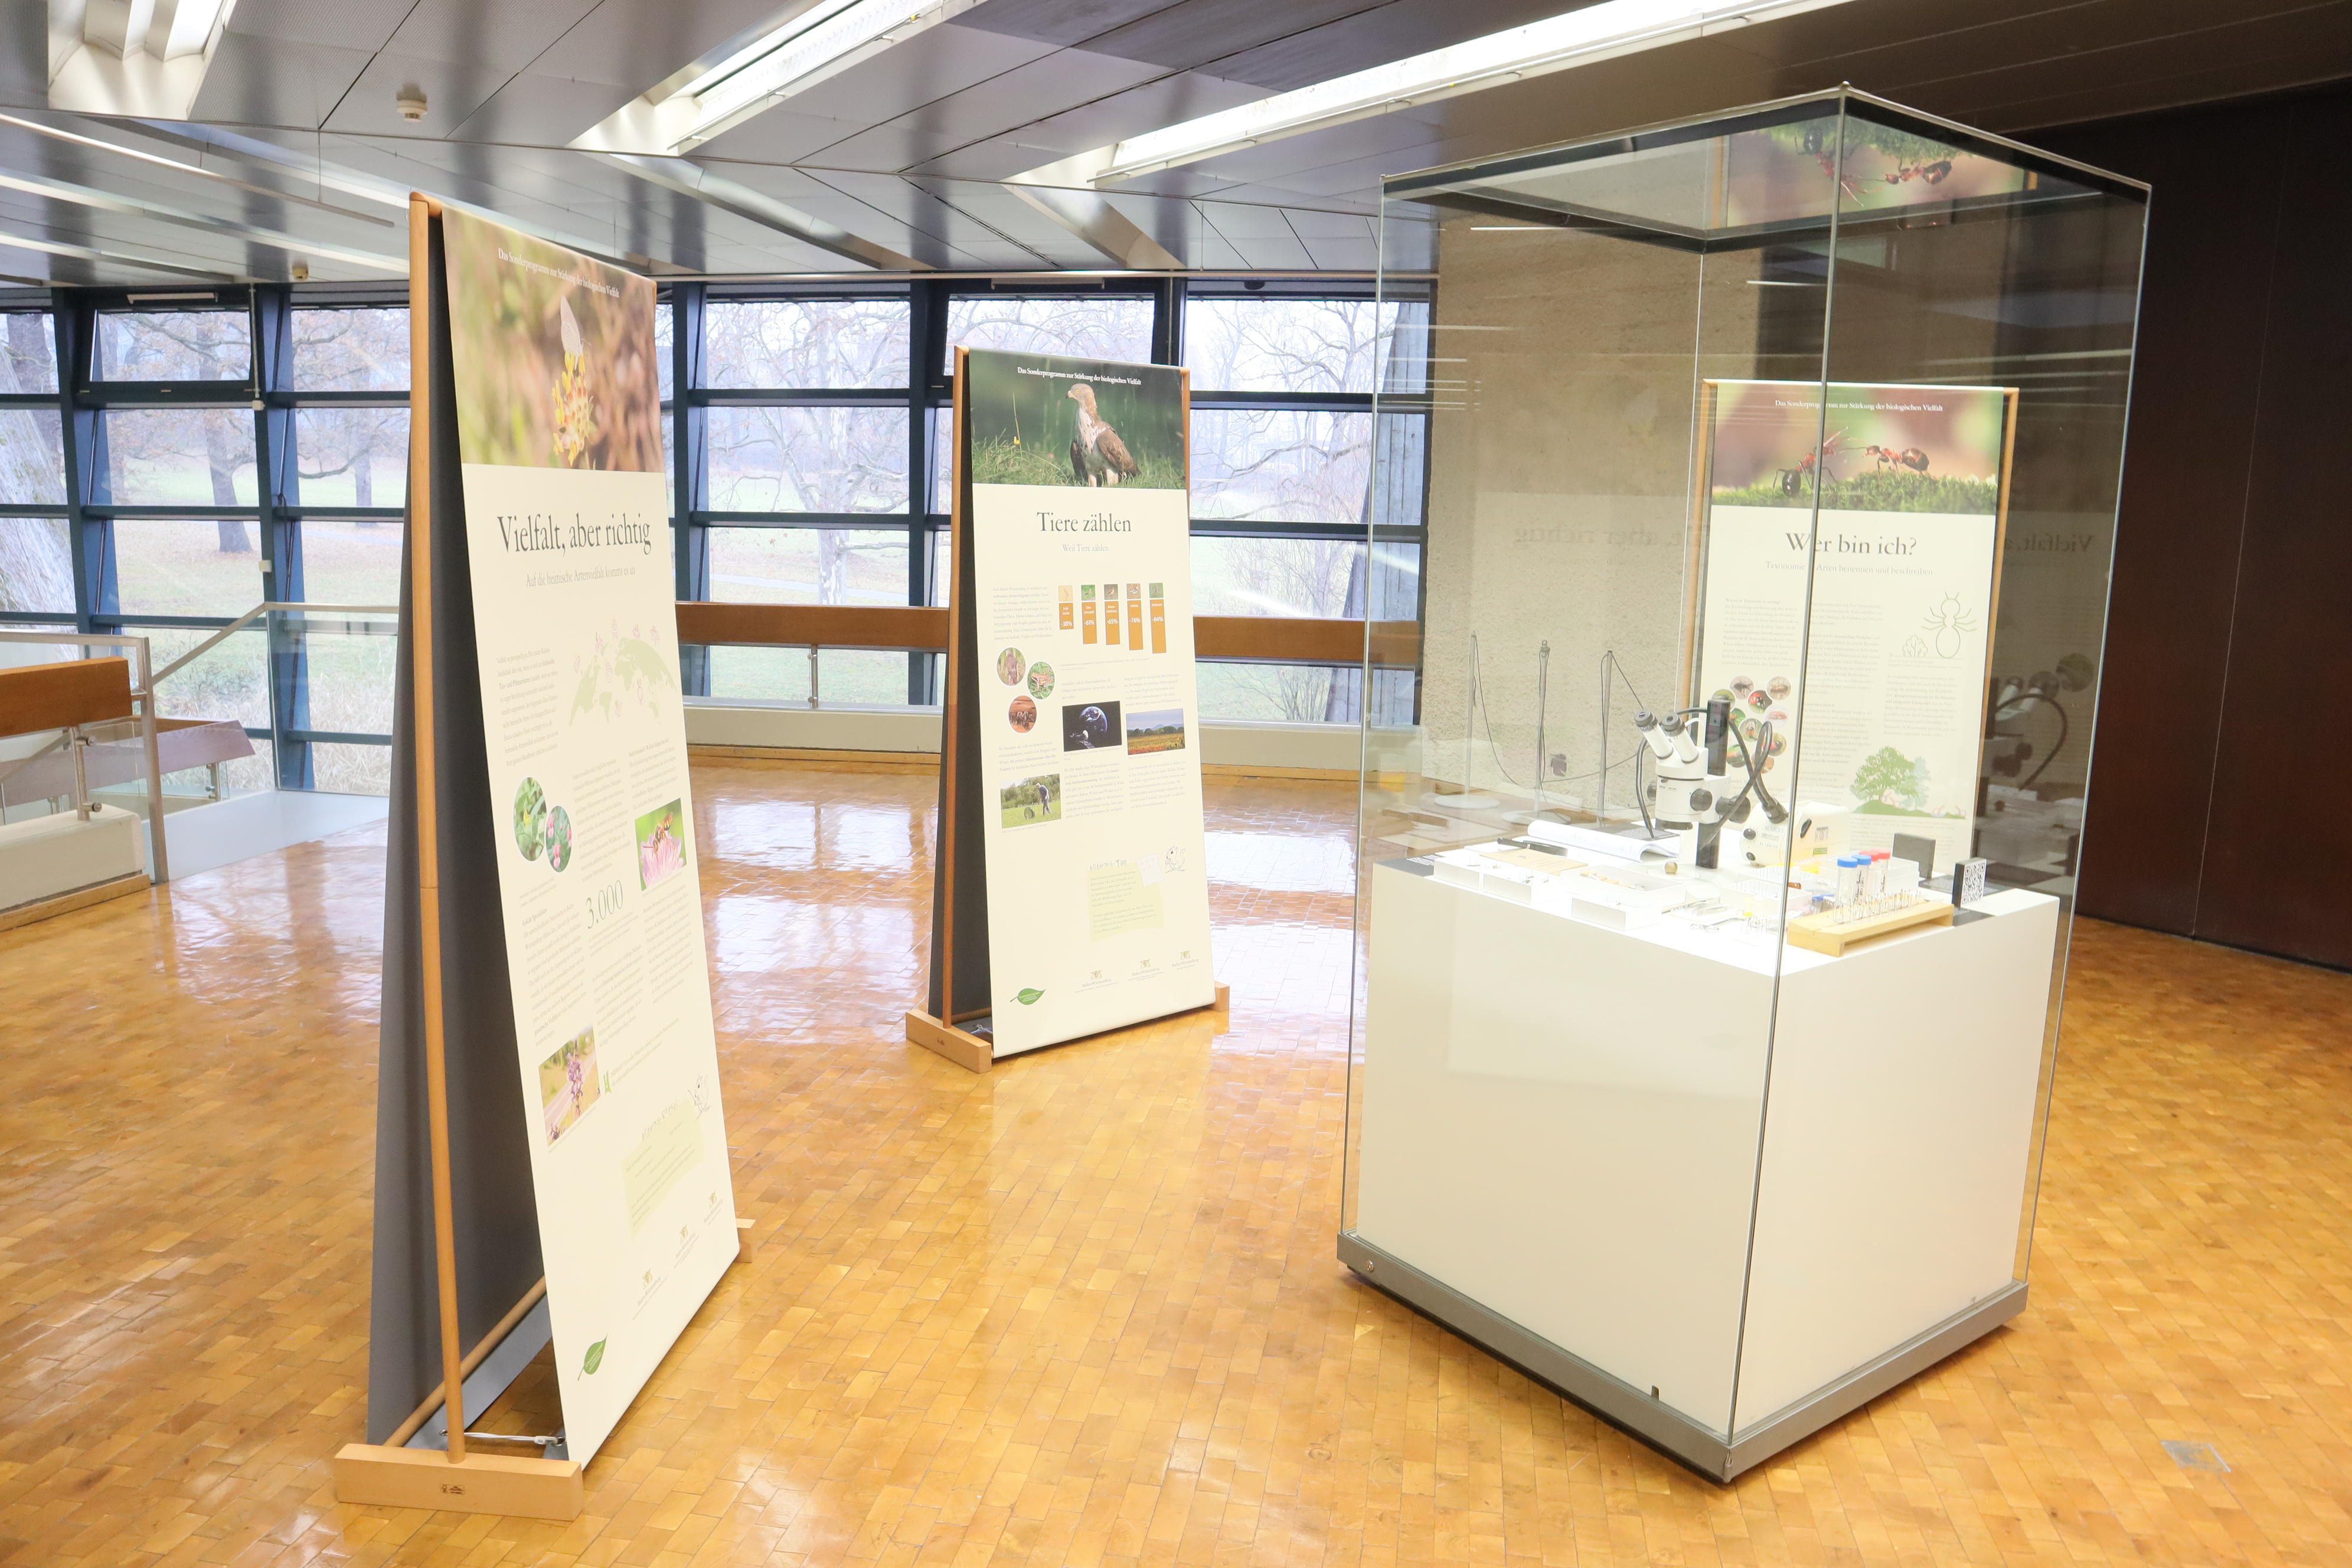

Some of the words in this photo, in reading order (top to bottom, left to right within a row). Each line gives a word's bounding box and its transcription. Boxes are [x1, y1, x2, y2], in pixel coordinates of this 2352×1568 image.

[498, 248, 508, 261] Das
[509, 252, 549, 274] Sonderprogramm
[558, 268, 576, 286] Stärkung
[583, 276, 606, 293] biologischen
[606, 285, 619, 298] Vielfalt
[1027, 368, 1066, 378] Sonderprogramm
[1074, 373, 1093, 381] Stärkung
[1101, 375, 1126, 384] biologischen
[1849, 402, 1875, 410] Stärkung
[1886, 403, 1921, 412] biologischen
[1037, 511, 1078, 532] Tiere
[1083, 512, 1132, 532] zählen
[496, 514, 566, 557] Vielfalt,
[569, 512, 601, 548] aber
[606, 512, 651, 555] richtig
[1785, 533, 1831, 551] Wer
[1838, 534, 1870, 554] bin
[1878, 536, 1917, 555] ich?
[527, 573, 536, 587] Auf
[537, 572, 545, 586] die
[547, 570, 573, 584] heimische
[574, 566, 605, 582] Artenvielfalt
[605, 566, 623, 577] kommt
[1766, 561, 1805, 570] Taxonomie
[1840, 564, 1873, 573] benennen
[1891, 567, 1933, 576] beschreiben
[586, 880, 623, 929] 3.000
